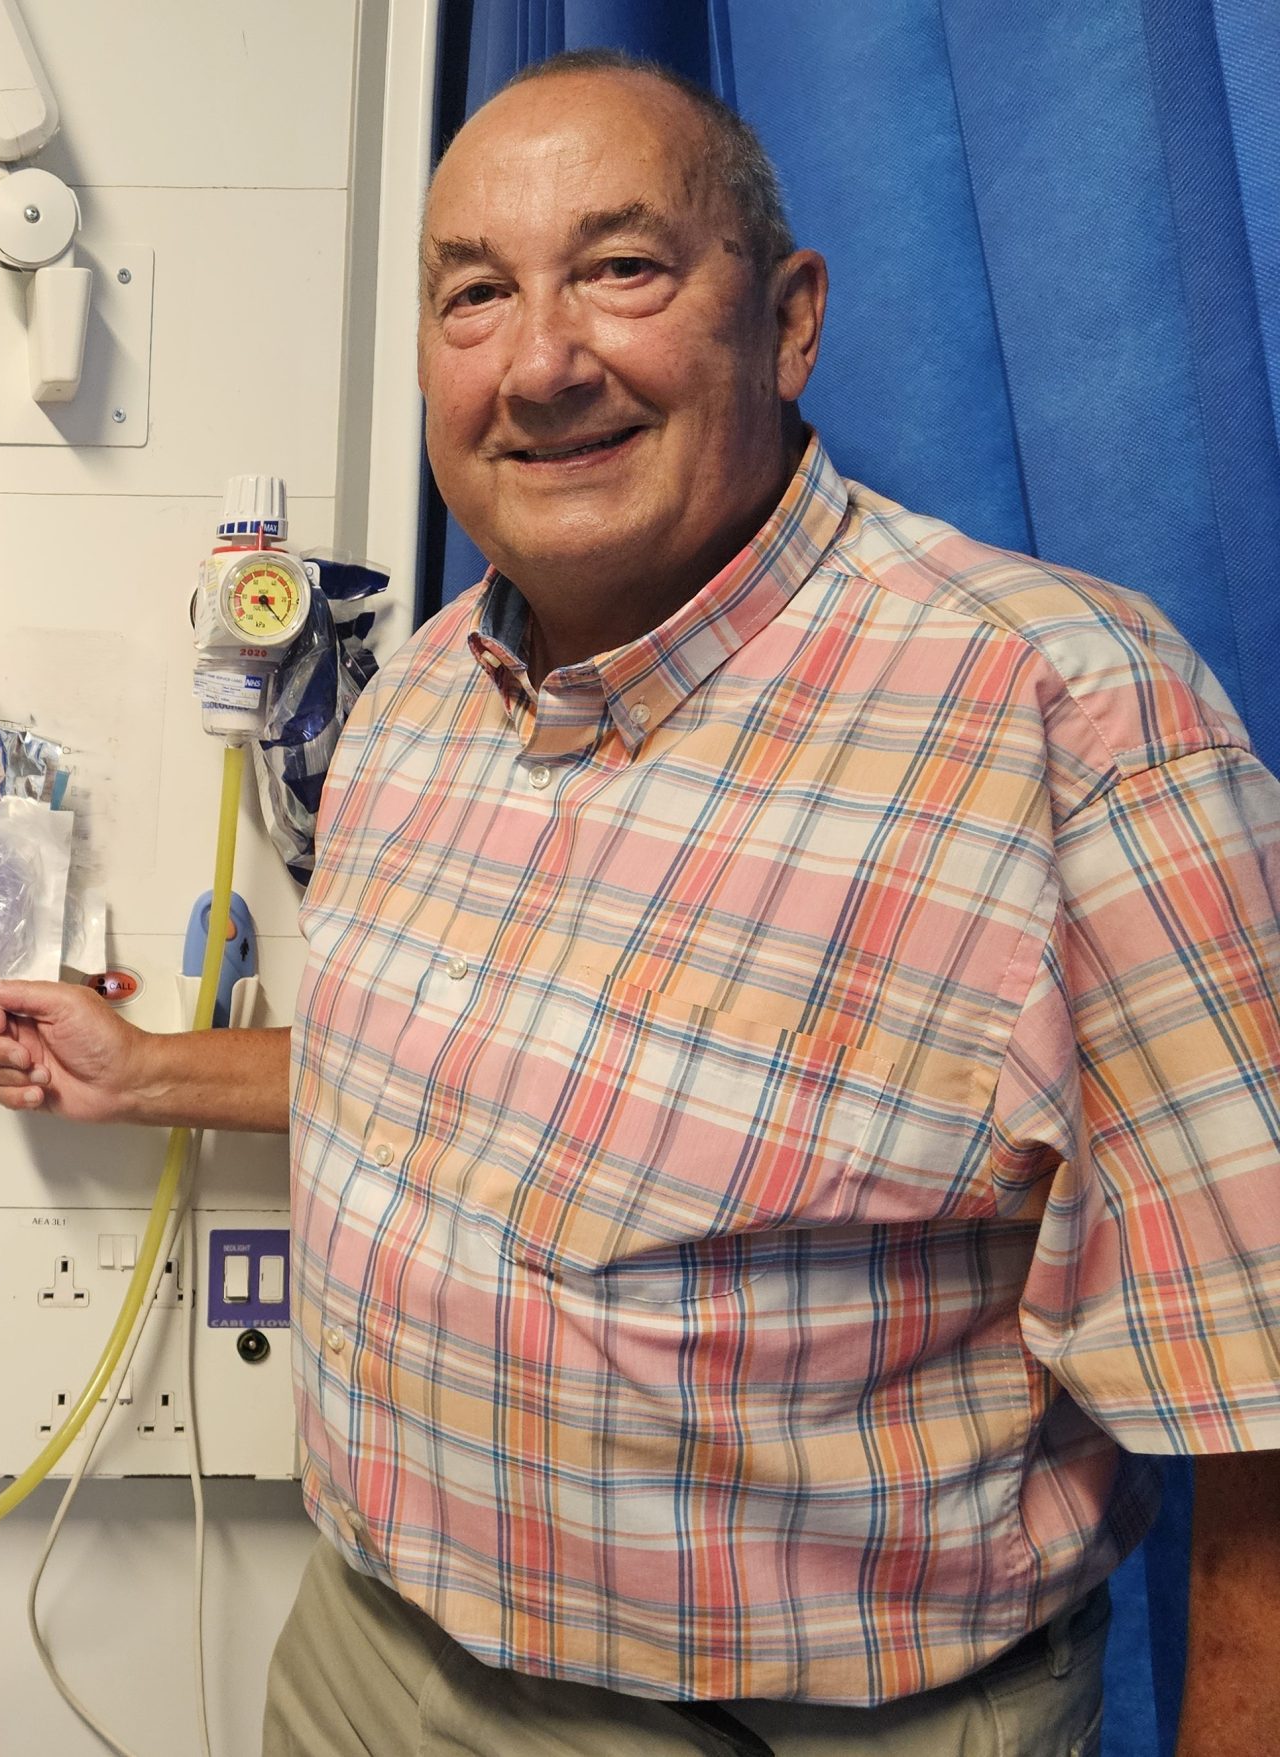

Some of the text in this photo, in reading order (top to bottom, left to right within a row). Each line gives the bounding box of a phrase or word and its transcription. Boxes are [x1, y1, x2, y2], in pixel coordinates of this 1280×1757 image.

[264, 523, 277, 533] MAX
[240, 648, 267, 658] 2020
[245, 679, 261, 688] NHS
[110, 982, 133, 991] CALL
[211, 1319, 290, 1327] CABLFLOW
